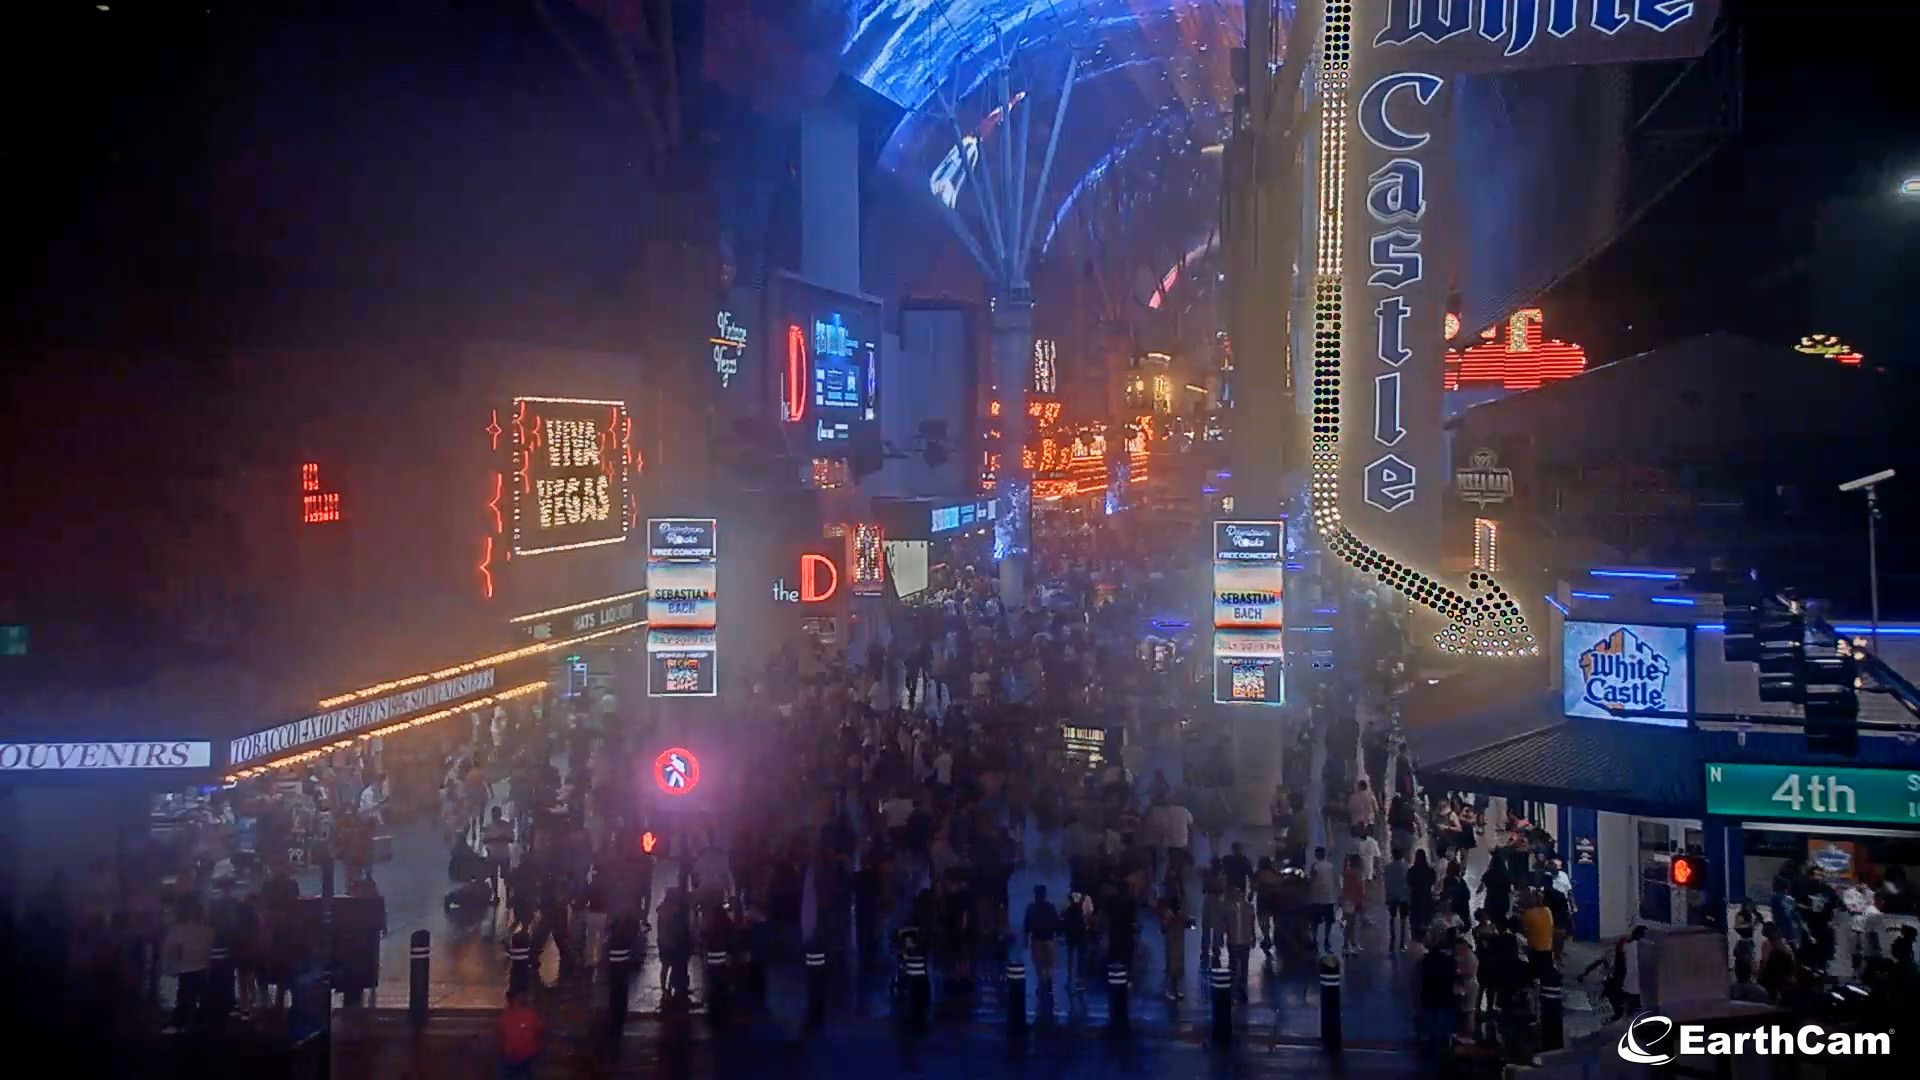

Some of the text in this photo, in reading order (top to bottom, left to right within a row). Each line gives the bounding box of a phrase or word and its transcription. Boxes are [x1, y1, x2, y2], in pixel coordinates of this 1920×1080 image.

[1358, 72, 1444, 512] Castle
[546, 419, 600, 467] VIVA
[537, 476, 610, 528] VEGAS
[772, 553, 838, 602] the D
[655, 588, 709, 600] SEBASTIAN
[668, 603, 697, 614] BACH
[1220, 592, 1276, 605] SEBASTIAN
[1233, 607, 1263, 620] BACH
[1591, 653, 1660, 683] White
[1586, 677, 1663, 707] Castle
[0, 743, 191, 768] OUVENIRS
[233, 724, 298, 764] TOBACCO
[1710, 766, 1723, 783] N
[1771, 773, 1857, 814] 4th
